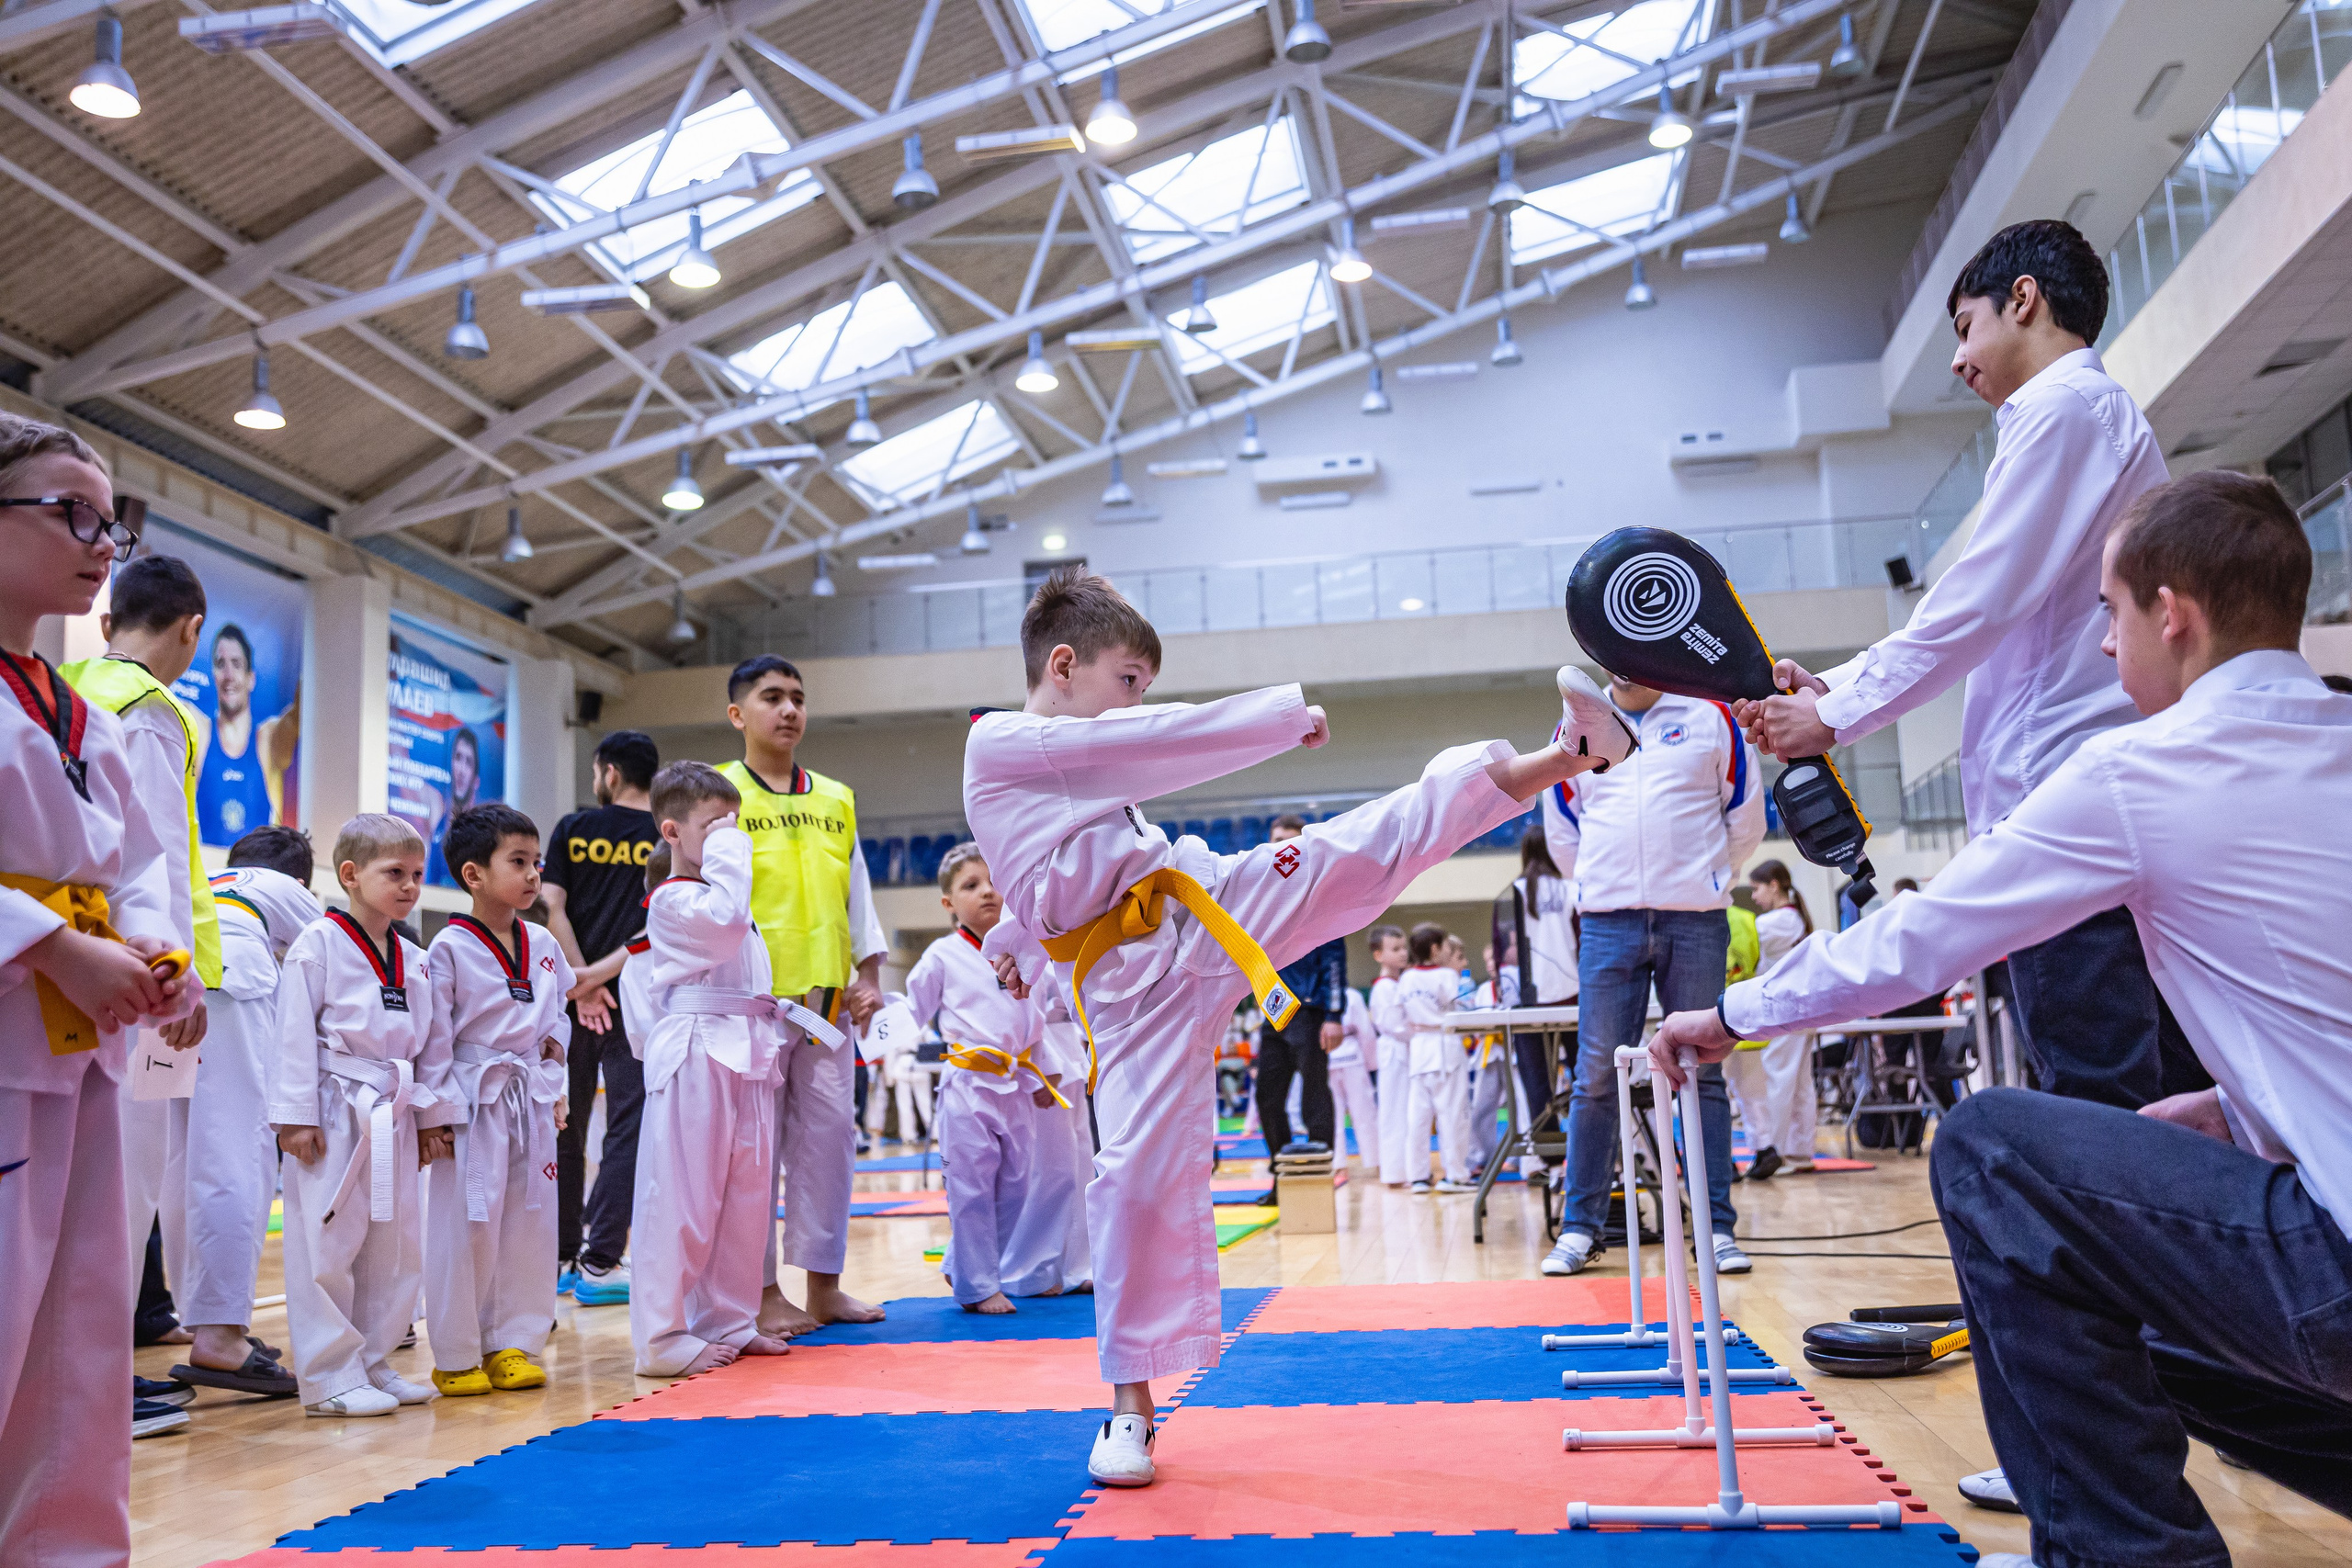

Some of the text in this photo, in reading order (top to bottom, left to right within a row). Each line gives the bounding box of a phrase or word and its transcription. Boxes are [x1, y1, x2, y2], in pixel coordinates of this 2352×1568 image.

[745, 812, 845, 834] ВОЛОНТЁР
[1826, 842, 1856, 859] Please charge
